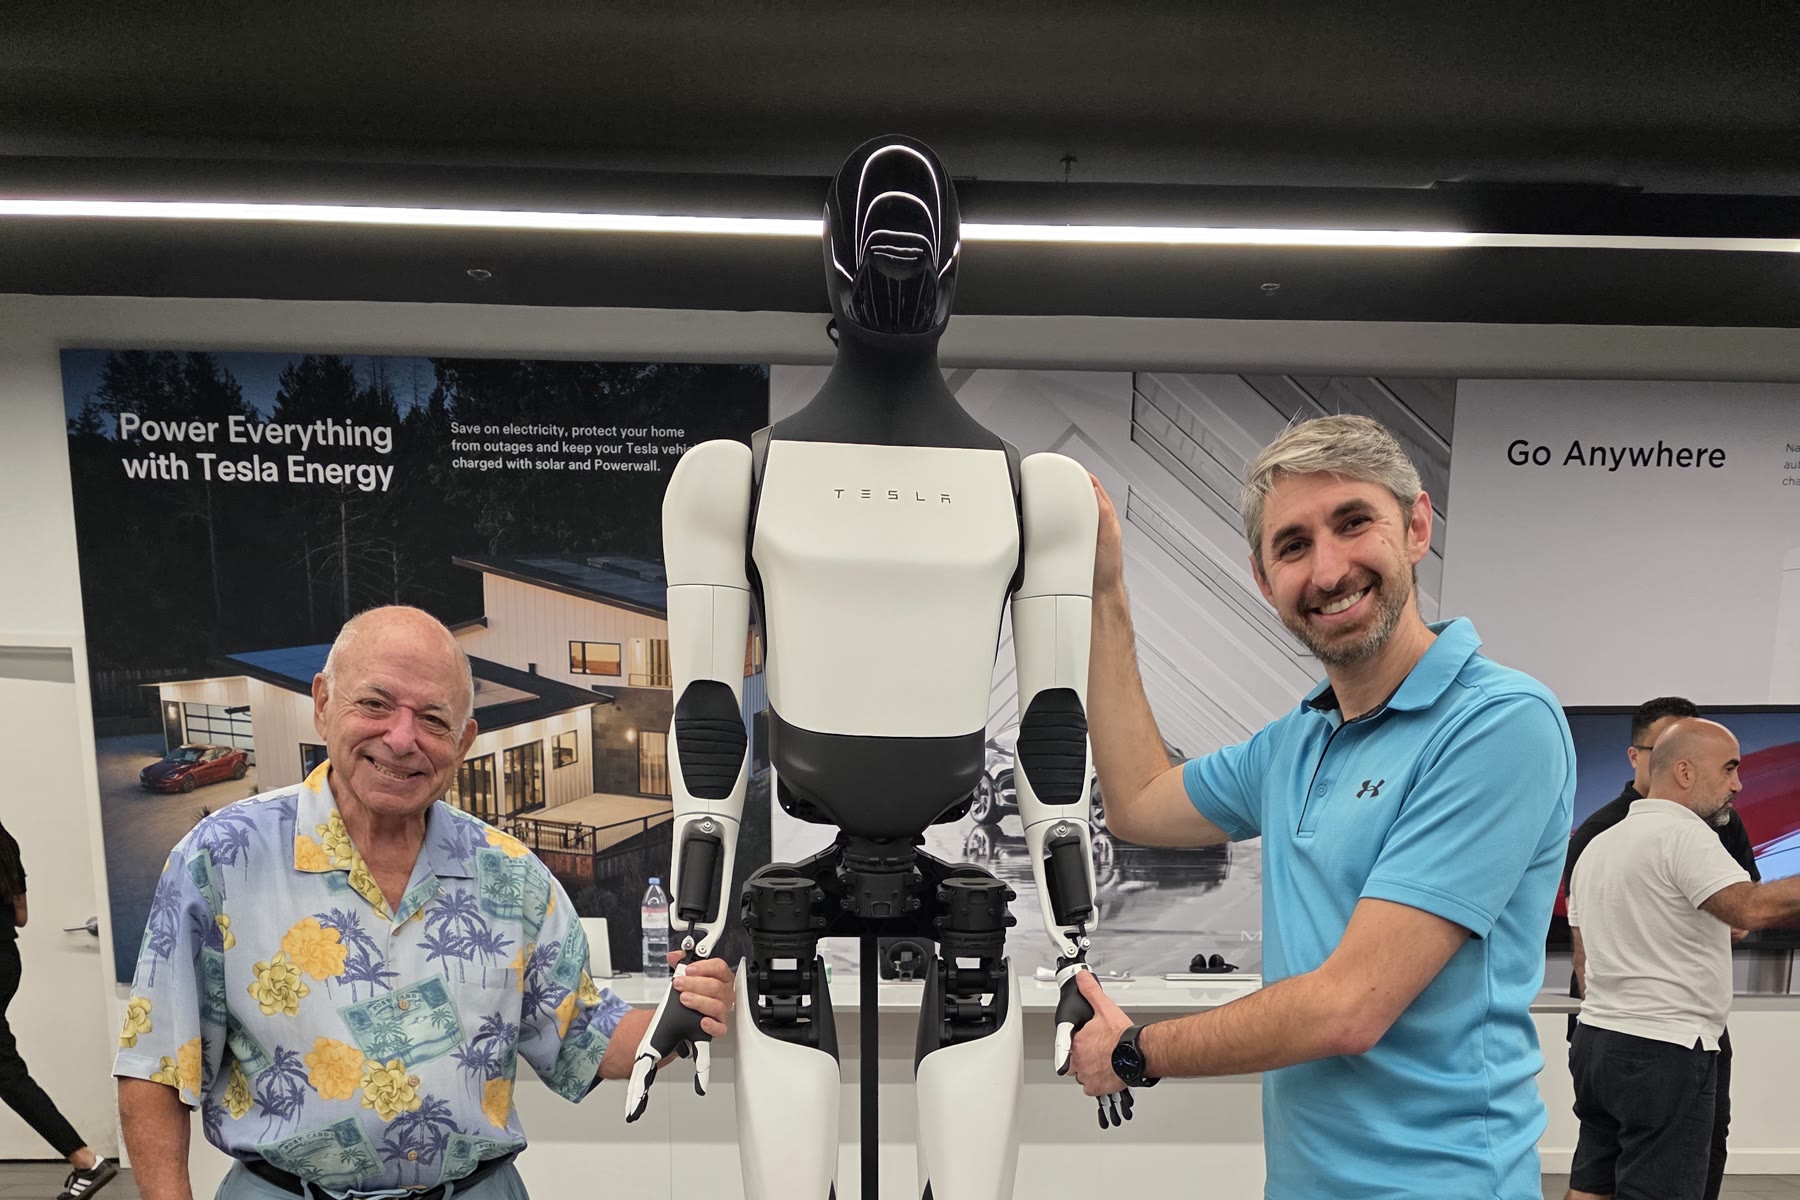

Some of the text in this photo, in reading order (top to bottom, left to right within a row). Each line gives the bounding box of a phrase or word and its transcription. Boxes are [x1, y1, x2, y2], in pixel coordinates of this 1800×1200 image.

[120, 412, 392, 453] Power Everything
[451, 422, 685, 439] Save on electricity, protect your home
[451, 439, 697, 455] from outages and keep your Tesla vehi
[1507, 439, 1726, 472] Go Anywhere
[121, 451, 394, 492] with Tesla Energy
[452, 457, 661, 471] charged with solar and Powerwall.
[834, 489, 951, 504] TESLA
